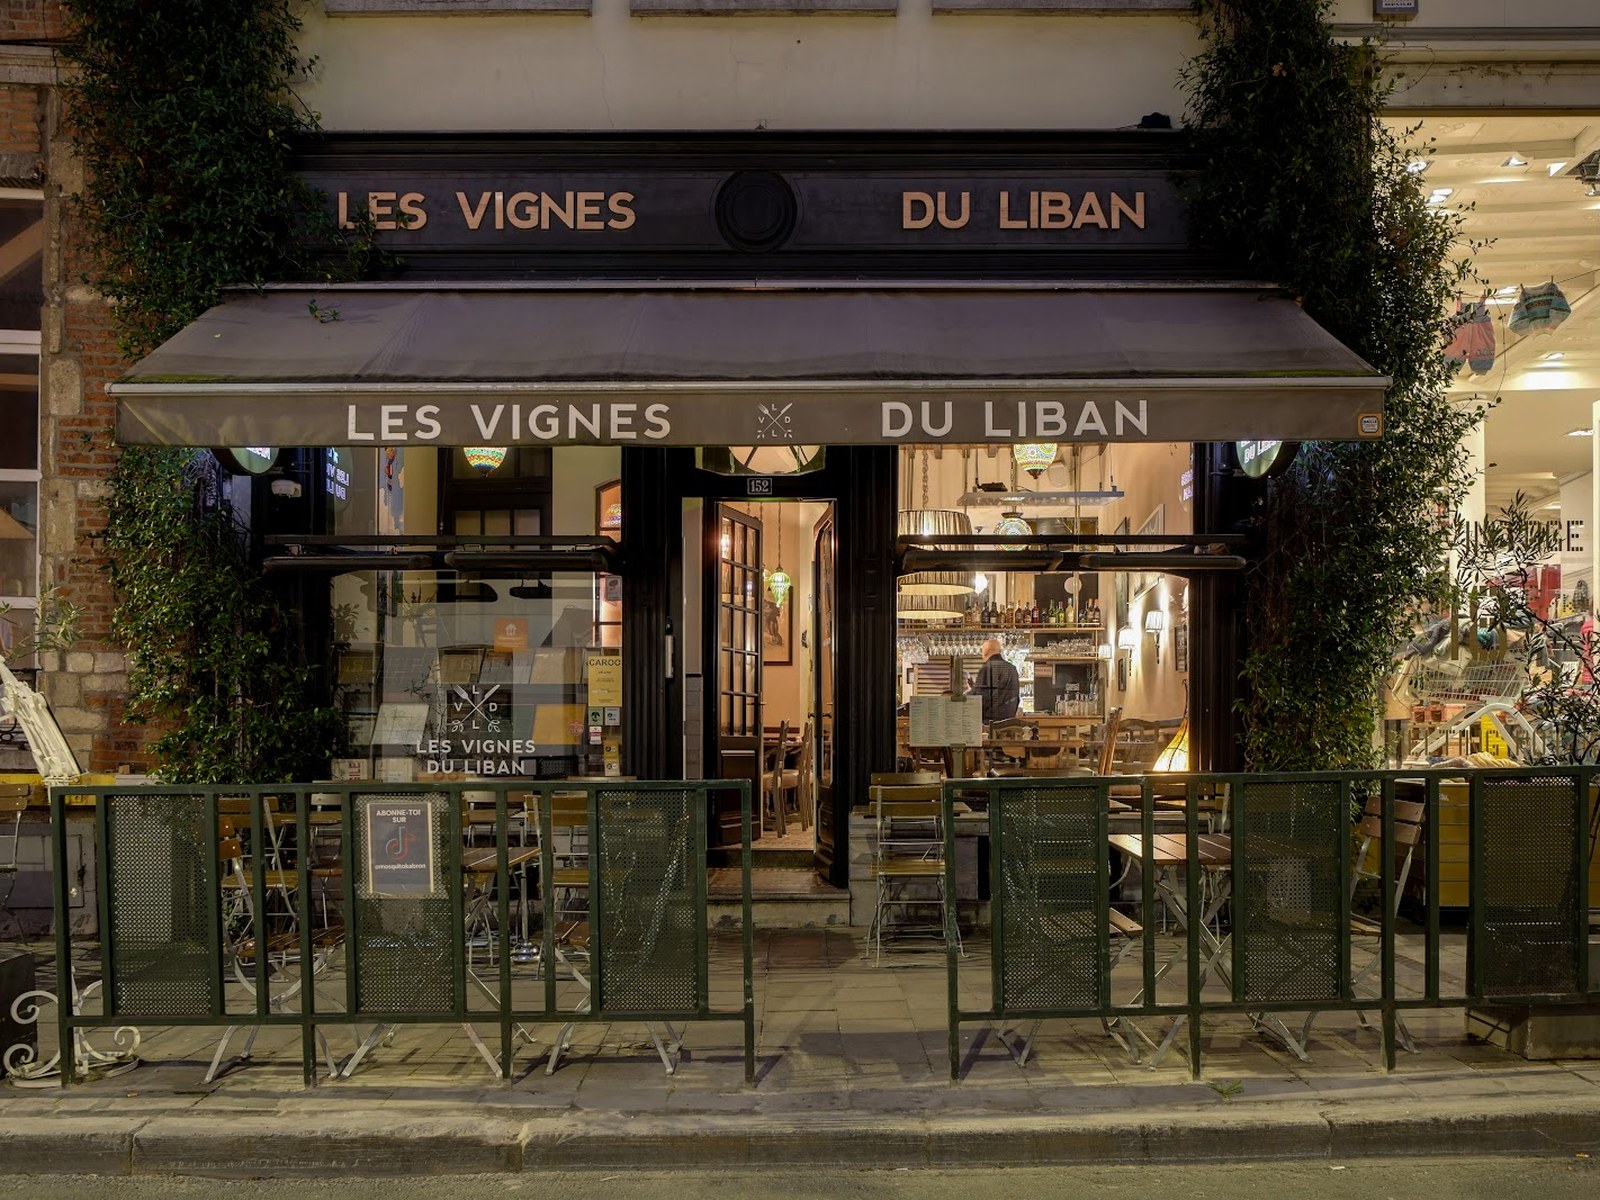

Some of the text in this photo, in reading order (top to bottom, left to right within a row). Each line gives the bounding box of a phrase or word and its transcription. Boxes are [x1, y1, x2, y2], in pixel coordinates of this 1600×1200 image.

[338, 191, 1146, 230] LES VIGNES DU LIBAN
[347, 403, 672, 441] LES VIGNES
[881, 400, 1149, 437] DU LIBAN
[750, 480, 769, 492] 152
[416, 739, 536, 754] LES VIGNES
[427, 760, 454, 775] DU
[464, 760, 525, 775] LIBAN
